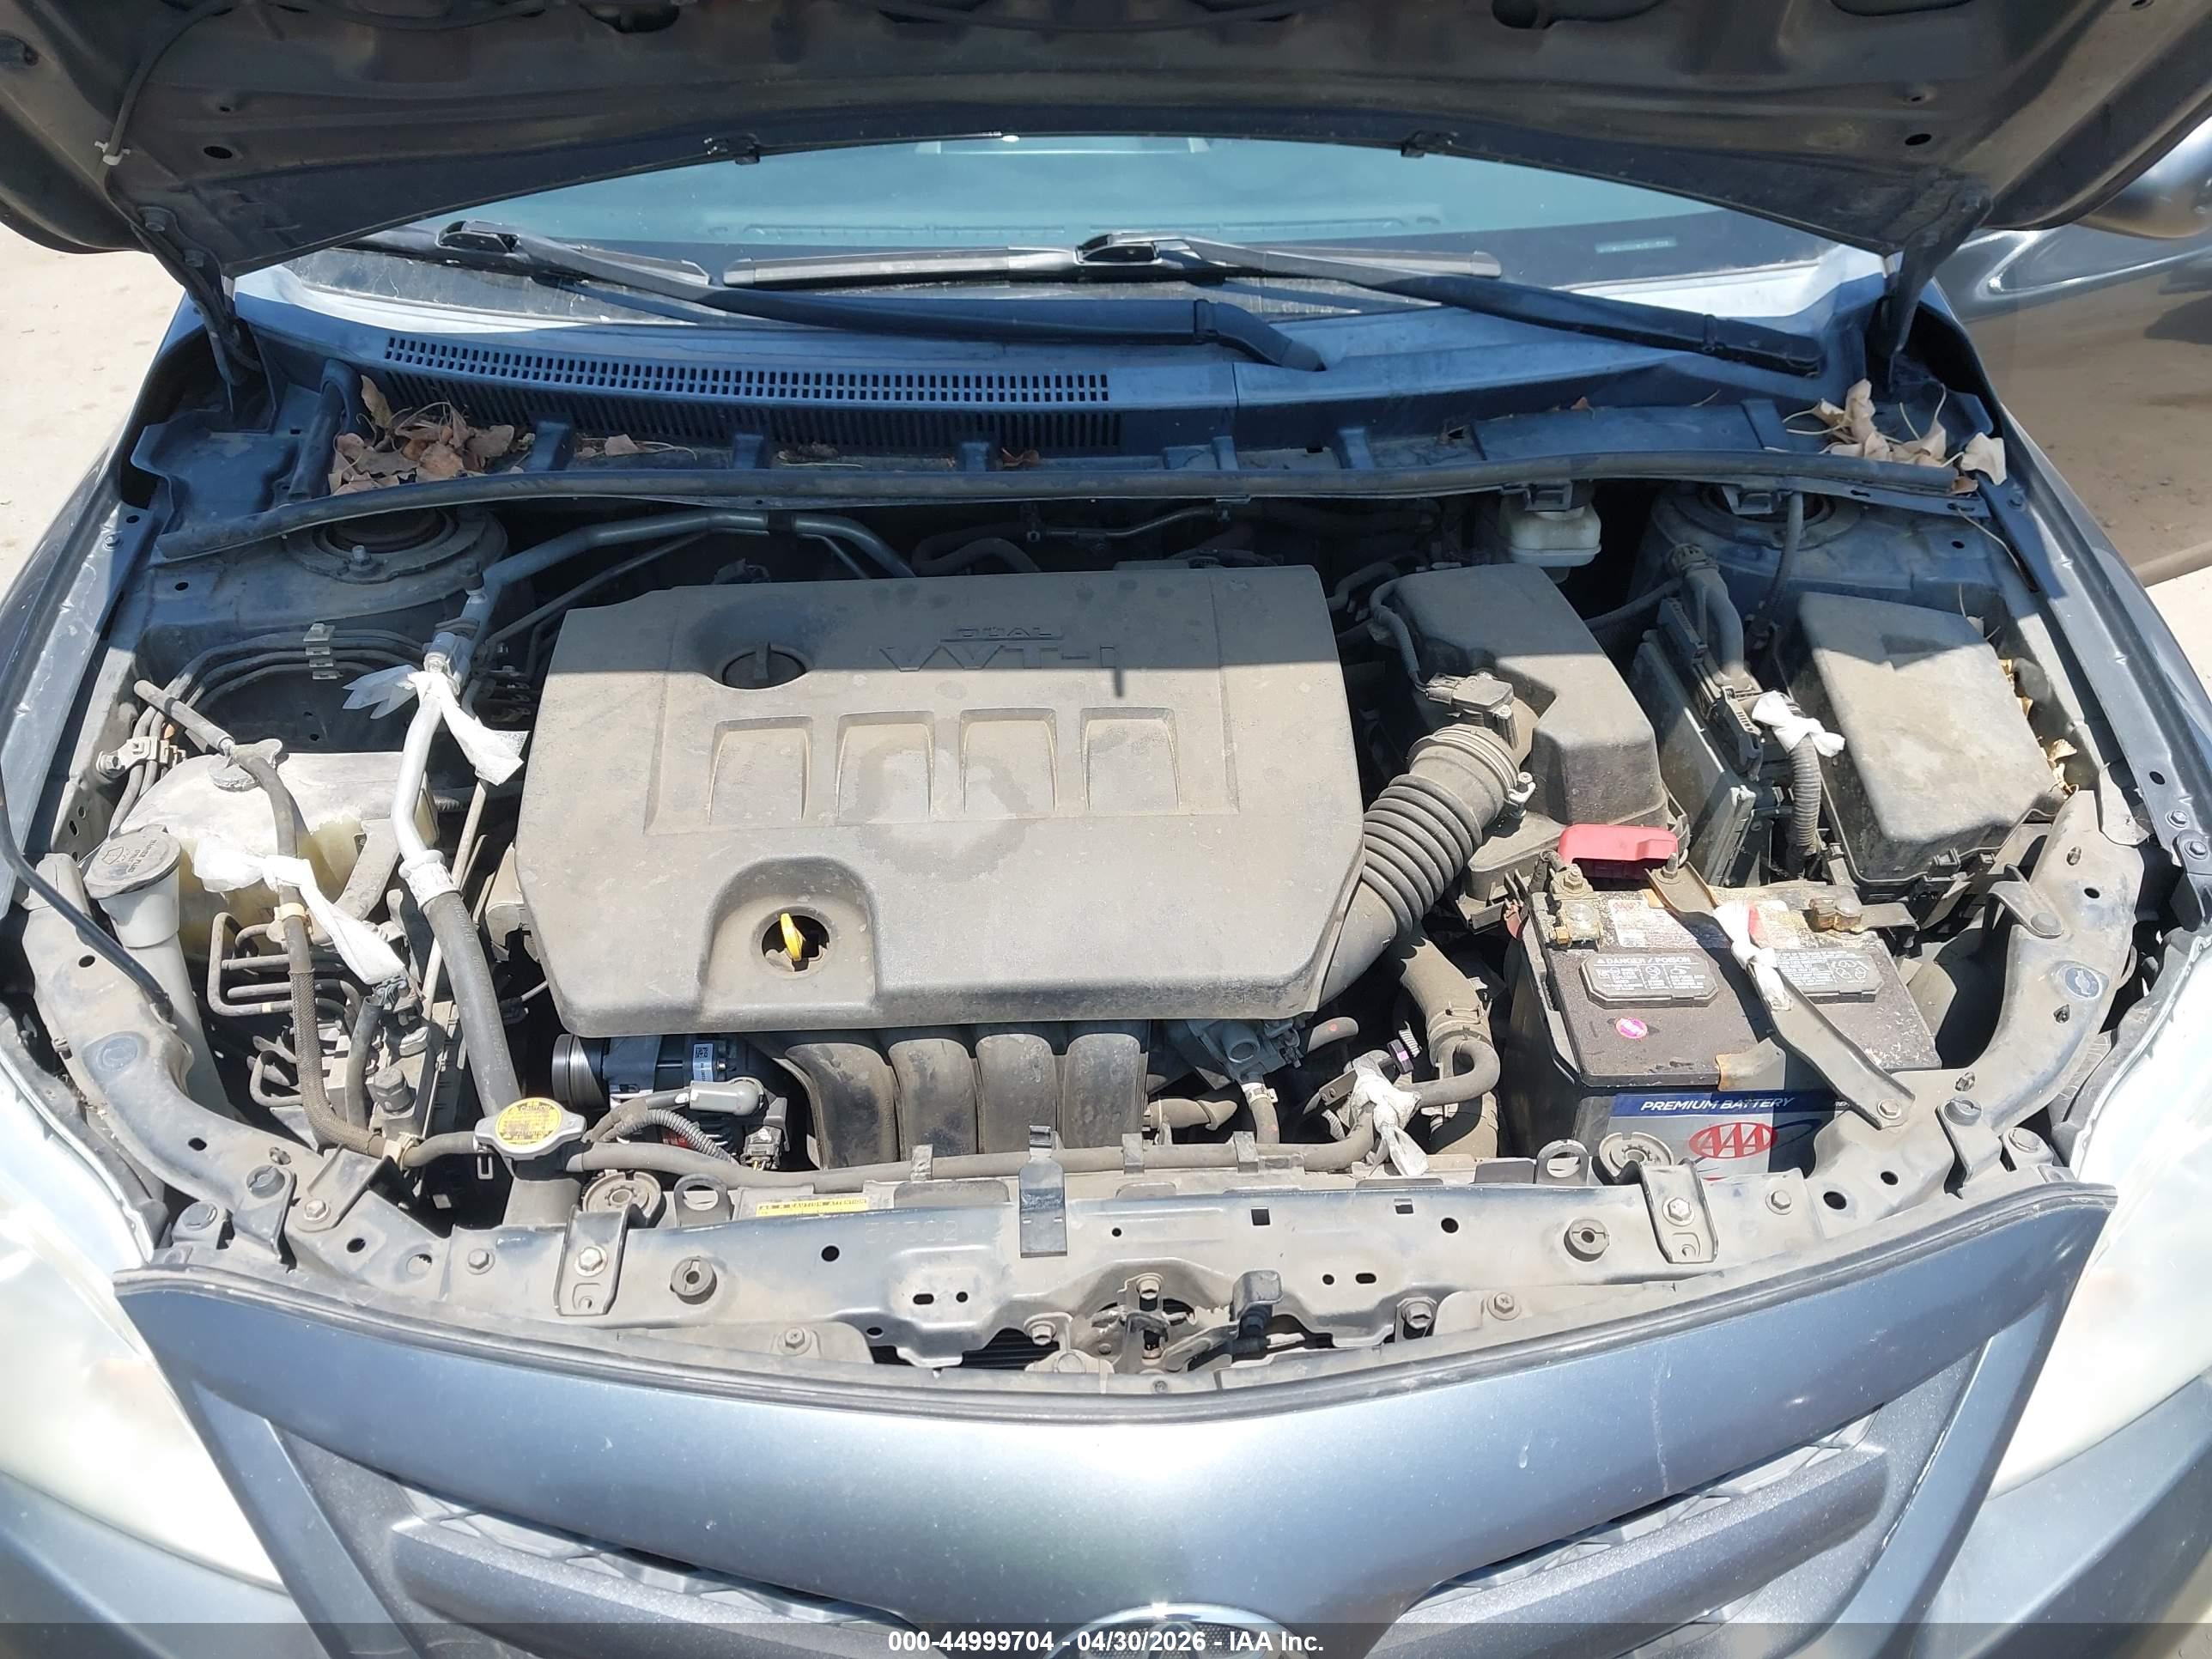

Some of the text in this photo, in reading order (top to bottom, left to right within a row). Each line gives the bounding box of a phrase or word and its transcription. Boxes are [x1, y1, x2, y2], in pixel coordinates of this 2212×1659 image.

[1640, 1097, 1795, 1111] PREMIUM BATTERY
[1696, 1122, 1771, 1158] AAA
